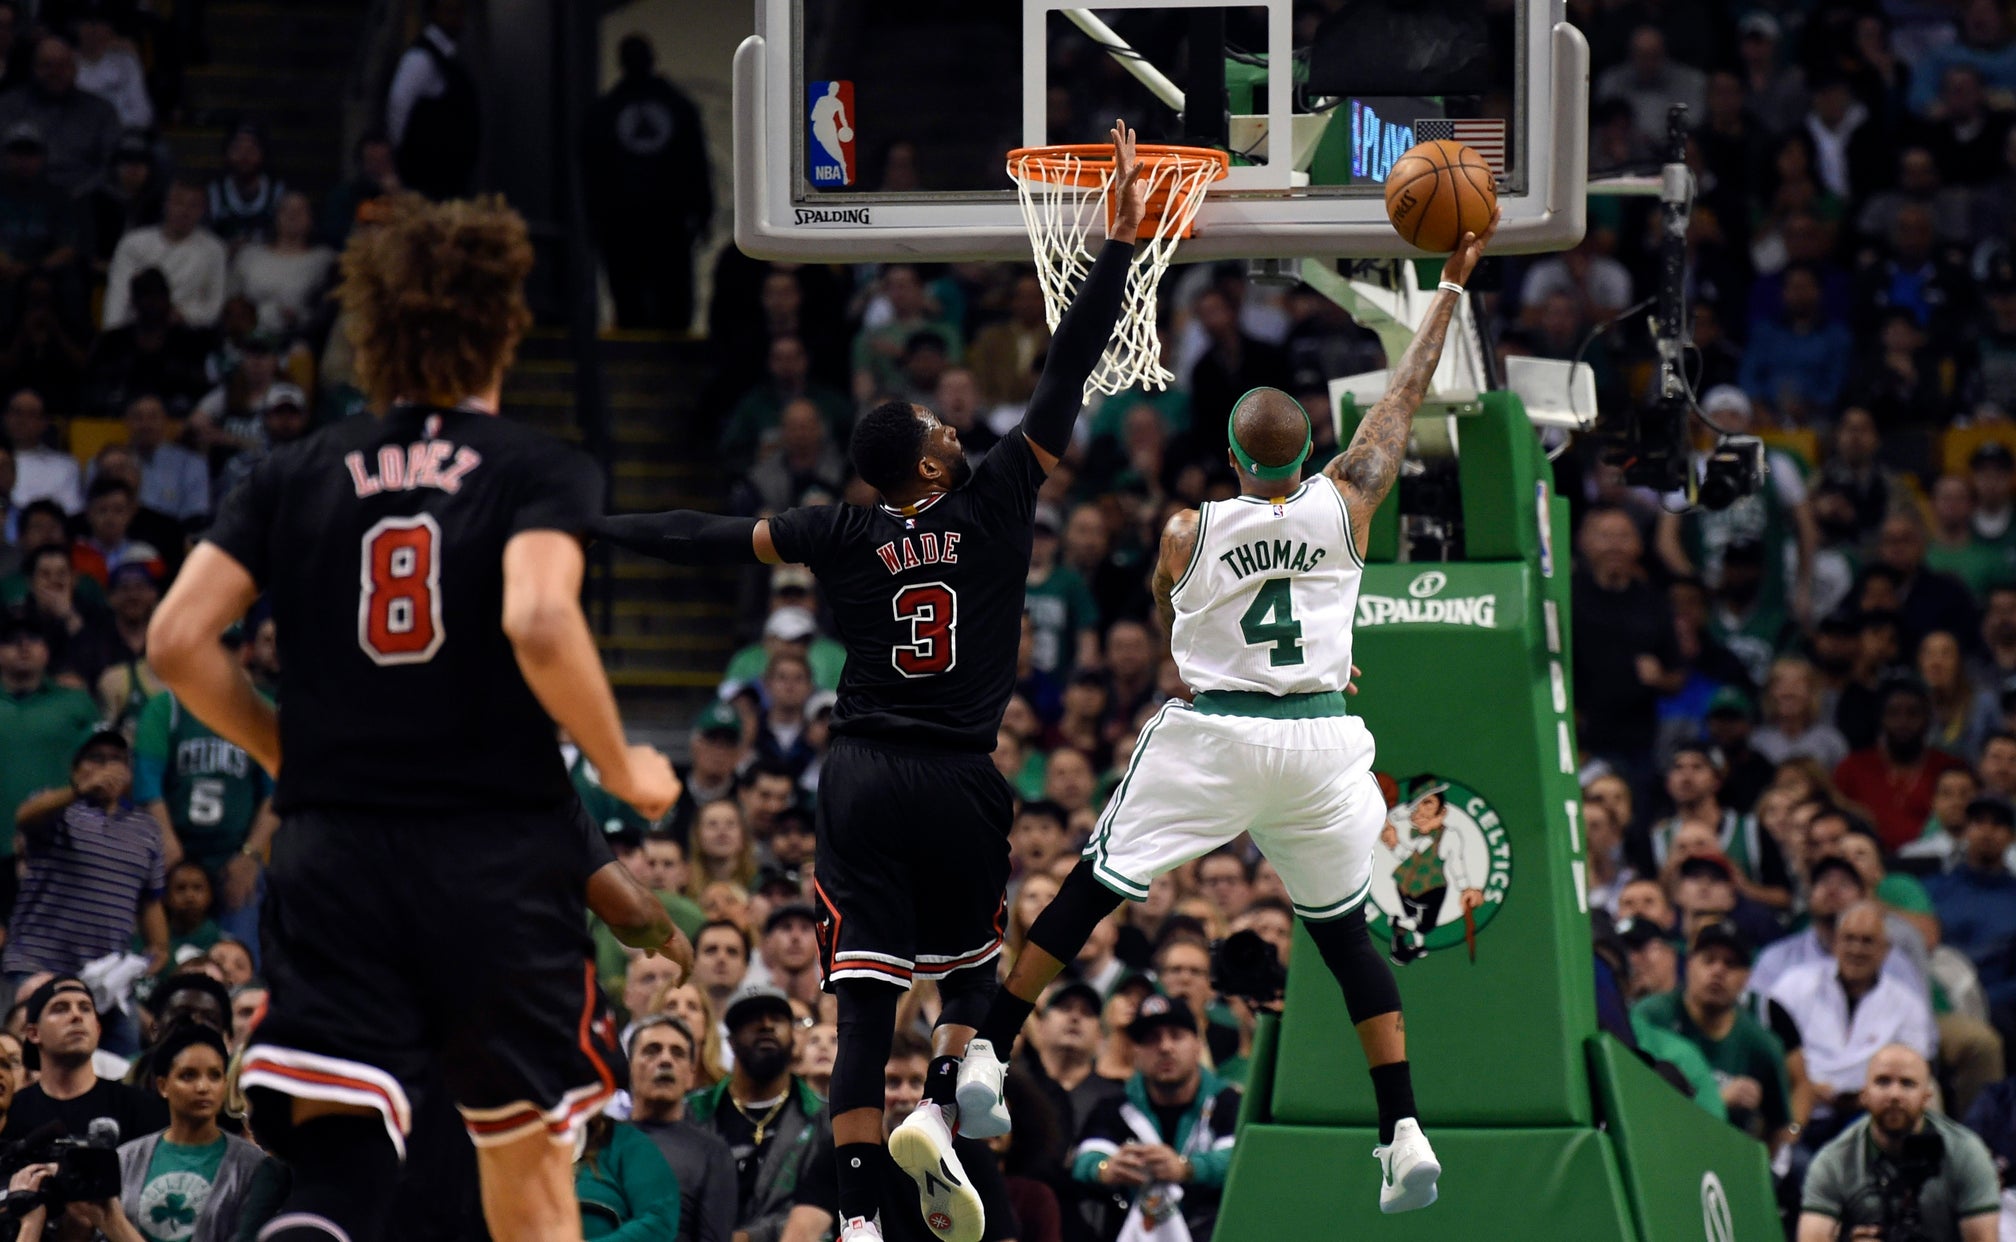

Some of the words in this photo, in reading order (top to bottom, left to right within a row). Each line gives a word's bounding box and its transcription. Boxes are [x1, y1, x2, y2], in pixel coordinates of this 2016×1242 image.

[815, 165, 841, 180] NBA
[795, 208, 870, 225] SPALDING
[345, 440, 482, 498] LOPEZ
[876, 532, 960, 576] WADE
[1219, 539, 1326, 580] THOMAS
[358, 511, 446, 667] 8
[1356, 594, 1497, 628] SPALDING
[892, 581, 957, 678] 3
[1239, 577, 1305, 667] 4
[188, 779, 225, 826] 5
[1466, 797, 1511, 905] CELTICS
